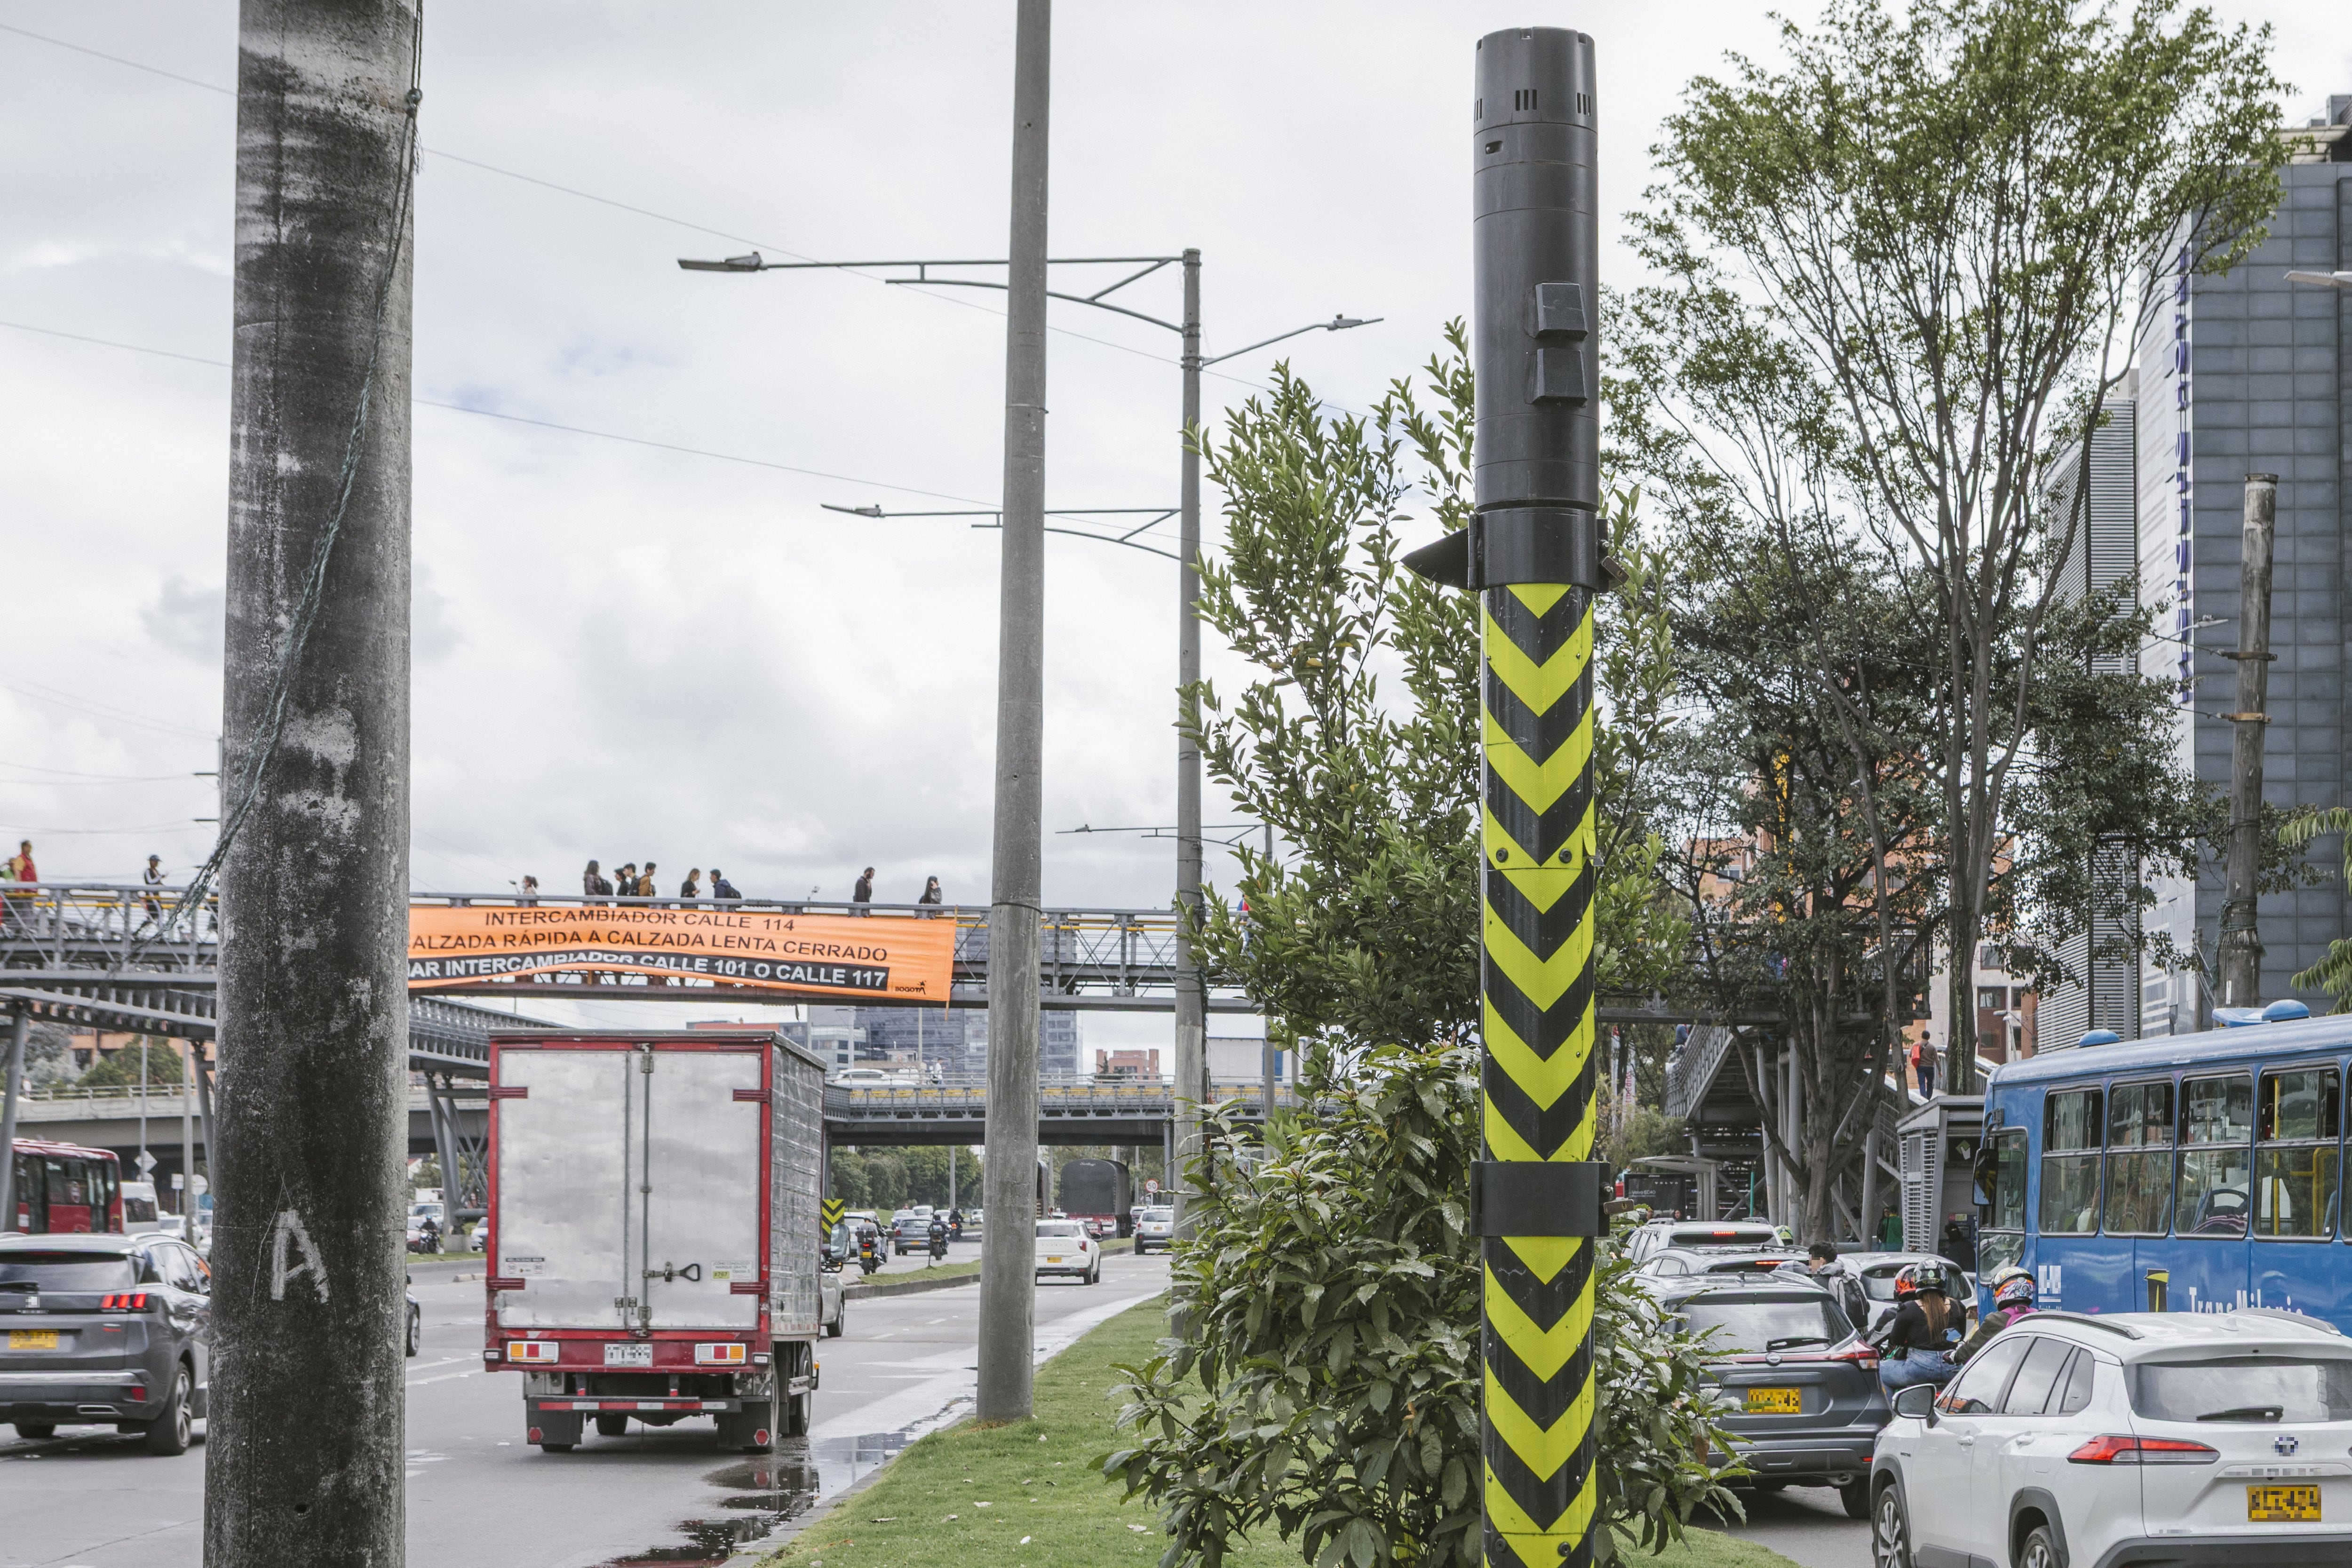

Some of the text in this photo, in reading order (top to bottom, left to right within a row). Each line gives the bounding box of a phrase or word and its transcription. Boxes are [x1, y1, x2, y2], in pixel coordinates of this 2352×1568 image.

[486, 910, 795, 931] INTERCAMBIADOR CALLE 114
[408, 930, 887, 961] ALZADA RÁPIDA A CALZADA LENTA CERRADO
[408, 951, 886, 987] AR INTERCAMBIADOR CALLE 101 O CALLE 117
[271, 1208, 329, 1303] A
[2189, 1287, 2303, 1314] TransMil
